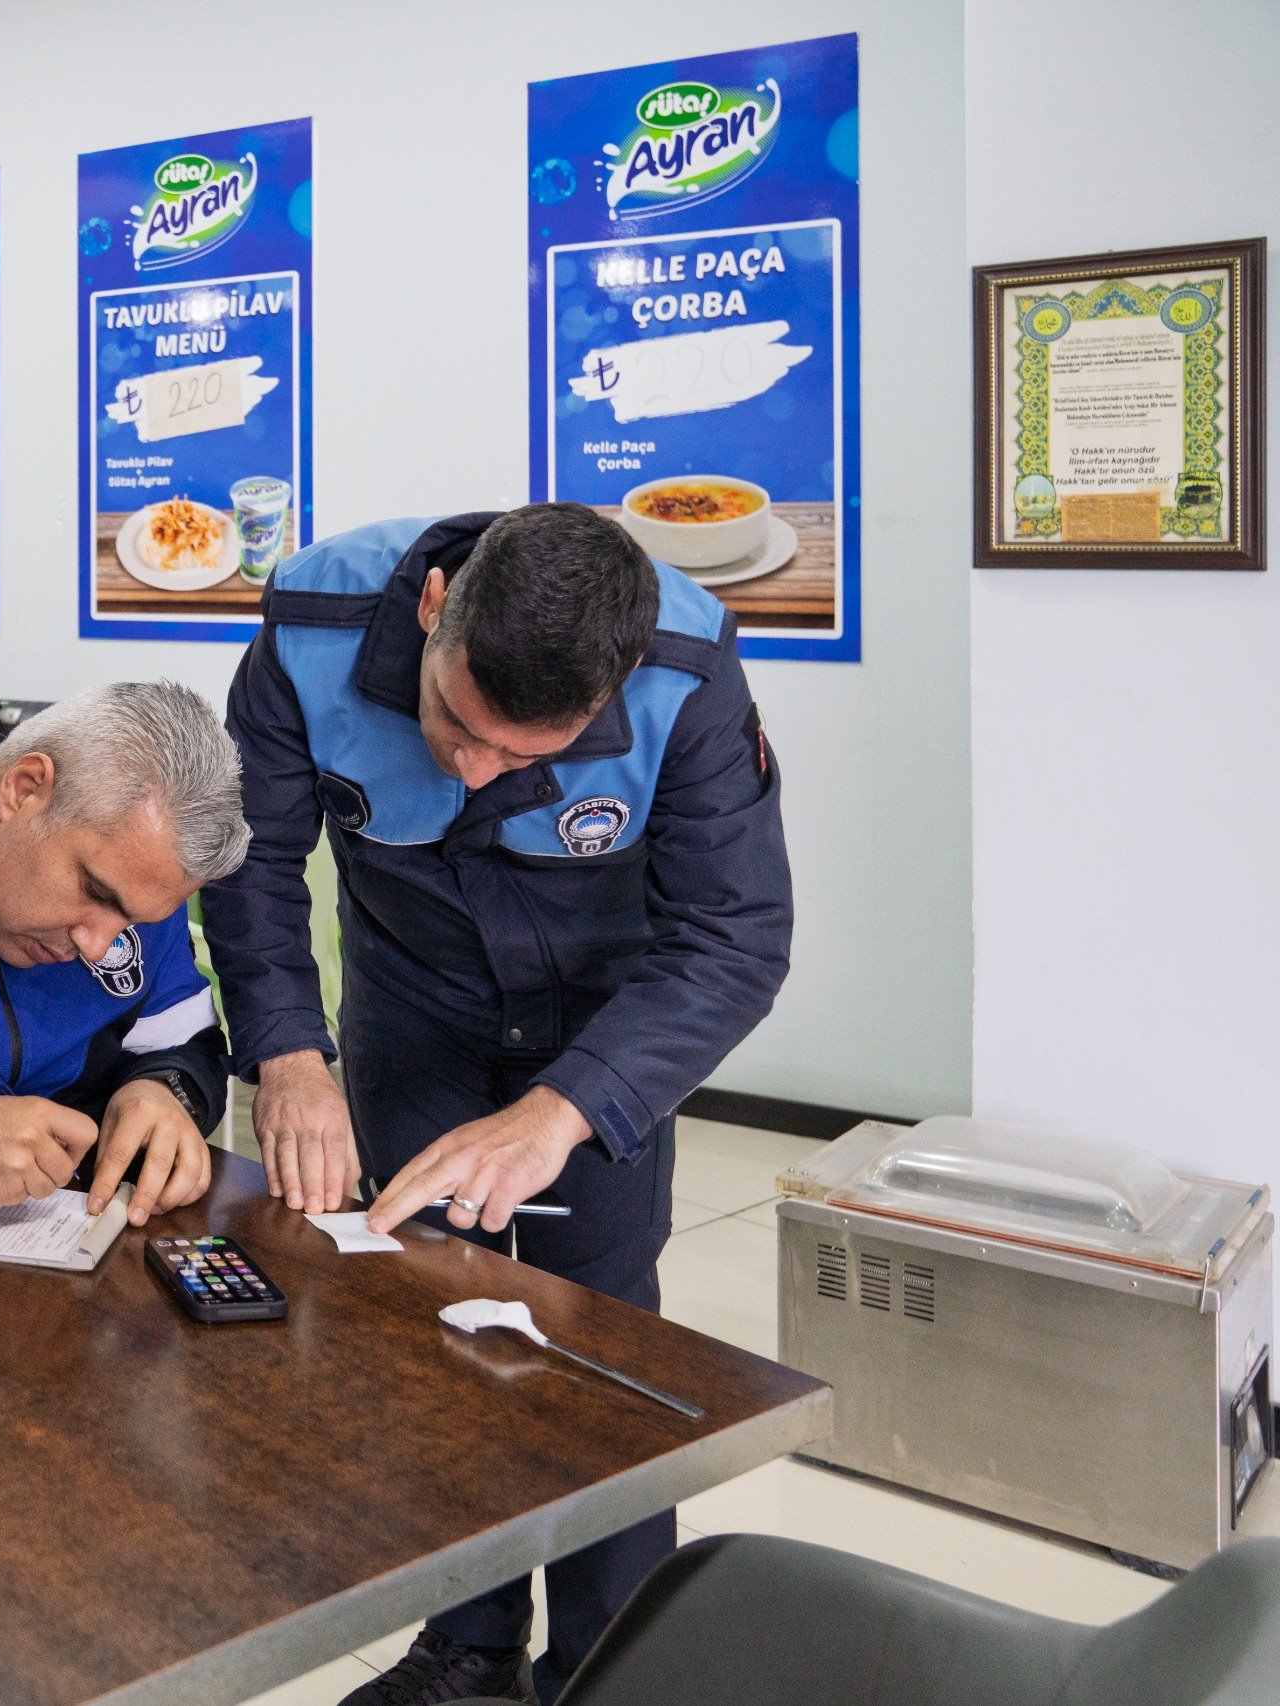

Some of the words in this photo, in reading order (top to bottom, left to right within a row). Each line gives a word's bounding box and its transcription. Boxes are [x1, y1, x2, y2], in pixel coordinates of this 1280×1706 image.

[625, 105, 756, 189] Ayran
[146, 175, 239, 244] Ayran
[596, 255, 686, 288] KELLE
[695, 246, 786, 282] PAÇA
[214, 289, 284, 319] PİLAV
[631, 289, 748, 329] ÇORBA
[155, 325, 227, 357] MENÜ
[168, 372, 223, 418] 220
[583, 441, 618, 454] Kelle
[621, 440, 656, 456] Paça
[106, 457, 146, 469] Tavuklu
[147, 456, 174, 468] Pilav
[597, 457, 641, 473] Çorba
[1111, 456, 1161, 465] kaynağıdır
[108, 476, 136, 488] Sütaş
[138, 475, 170, 488] Ayran
[1097, 477, 1118, 486] gelir
[577, 801, 615, 812] ZABITA
